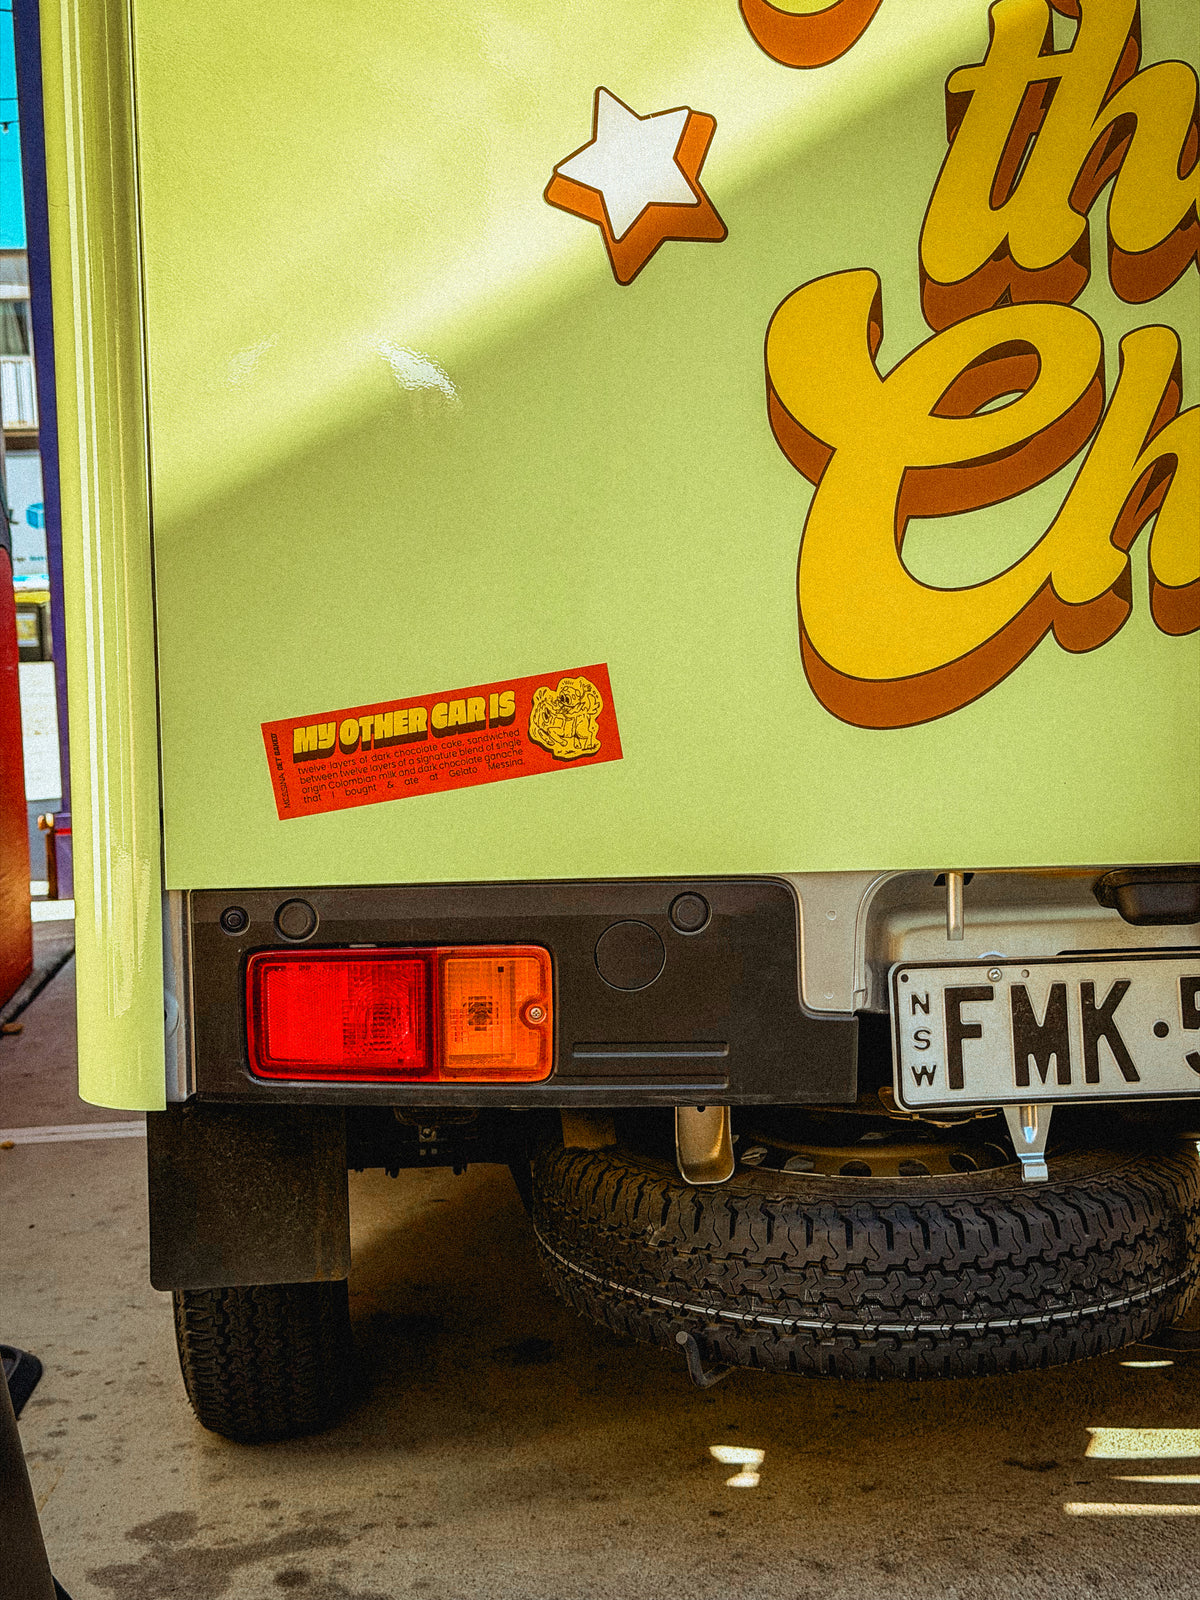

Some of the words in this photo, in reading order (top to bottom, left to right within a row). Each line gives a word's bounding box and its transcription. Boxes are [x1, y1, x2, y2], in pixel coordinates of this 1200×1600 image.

[920, 0, 1200, 335] th
[293, 721, 337, 764] MY
[338, 706, 428, 755] OTHER
[431, 696, 486, 739] CAR
[489, 690, 516, 729] IS
[275, 757, 284, 771] GET
[297, 763, 327, 775] twelve
[329, 758, 357, 770] layers
[370, 751, 392, 762] dark
[393, 744, 438, 758] chocolate
[466, 727, 520, 745] sandwiched
[299, 772, 339, 785] between
[339, 766, 369, 778] twelve
[369, 761, 397, 772] layers
[416, 750, 458, 765] signature
[458, 744, 485, 756] blend
[495, 739, 522, 750] single
[301, 783, 327, 795] origin
[327, 775, 377, 790] Colombian
[378, 770, 398, 780] milk
[398, 767, 417, 777] and
[417, 763, 438, 774] dark
[438, 756, 483, 770] chocolate
[483, 748, 524, 764] ganache
[303, 793, 322, 804] that
[344, 783, 377, 797] bought
[403, 777, 419, 786] ate
[448, 766, 478, 778] Gelato
